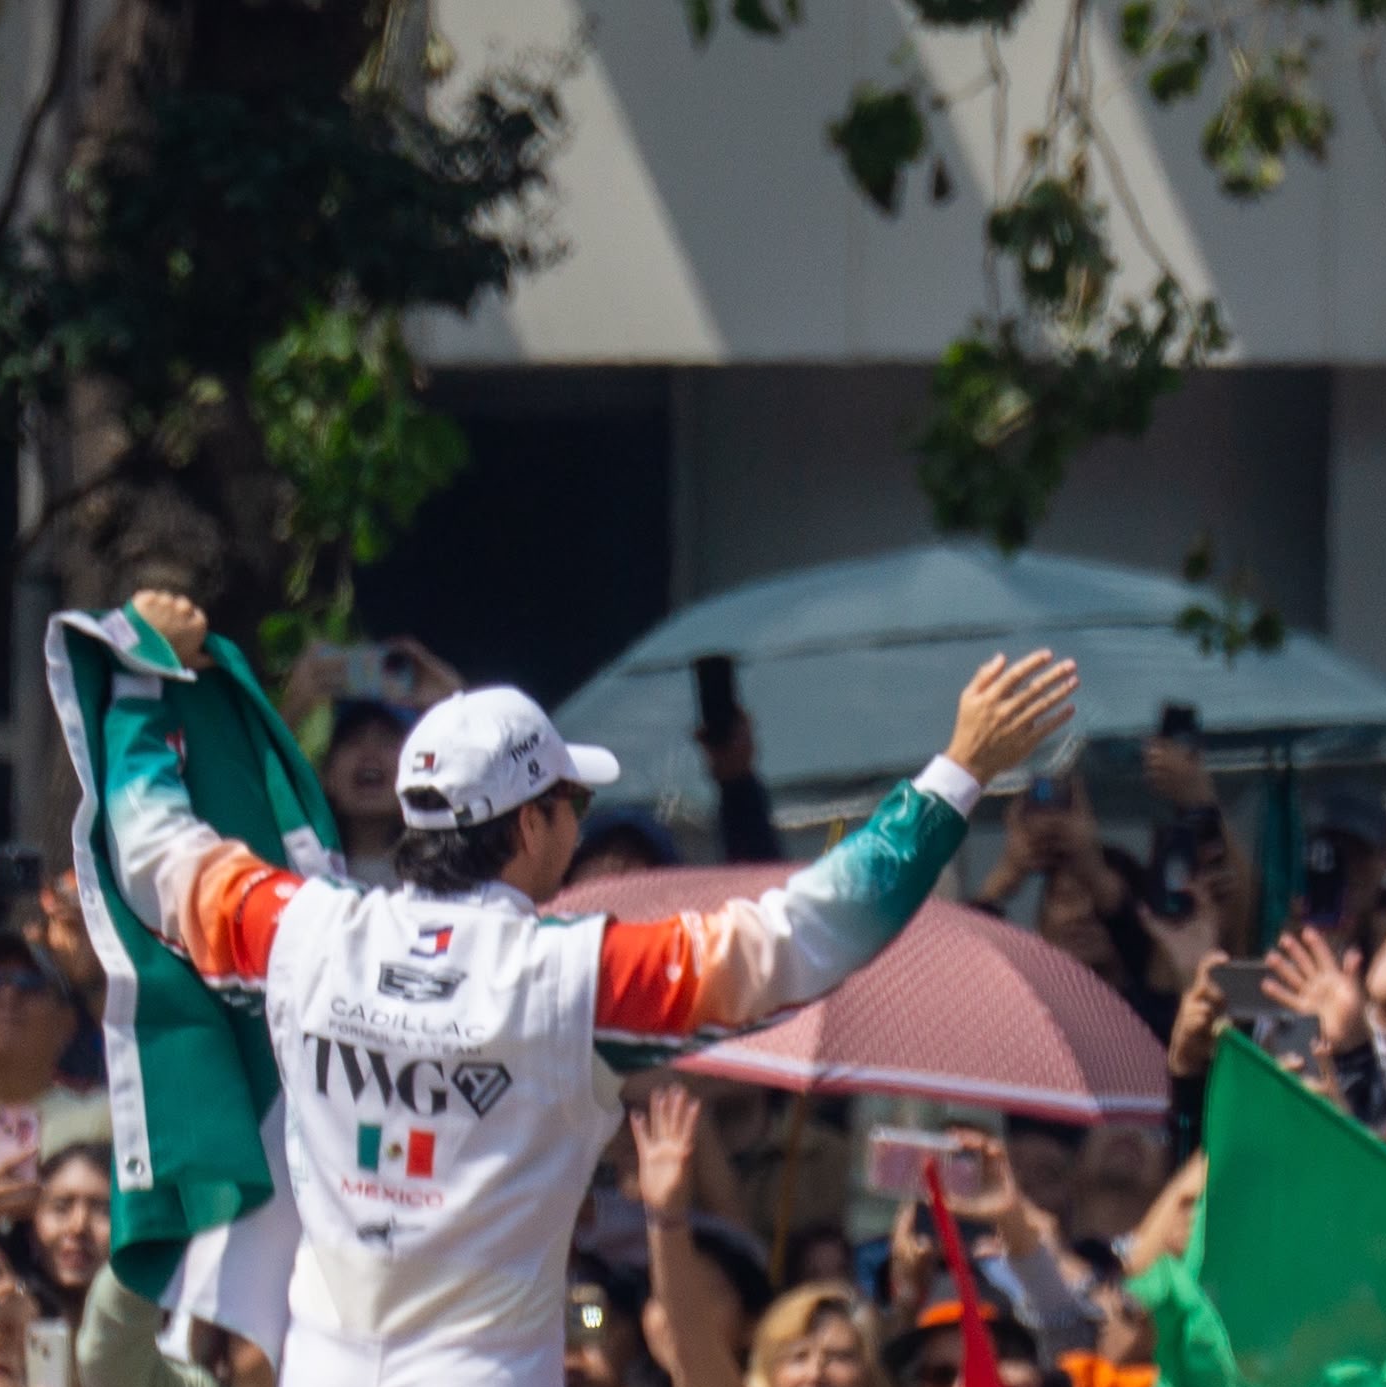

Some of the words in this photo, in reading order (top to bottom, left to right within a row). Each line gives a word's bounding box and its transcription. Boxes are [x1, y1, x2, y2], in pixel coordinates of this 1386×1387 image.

[329, 995, 488, 1043] CADILLAC
[302, 1033, 449, 1117] TWG
[340, 1176, 445, 1207] MEXICO
